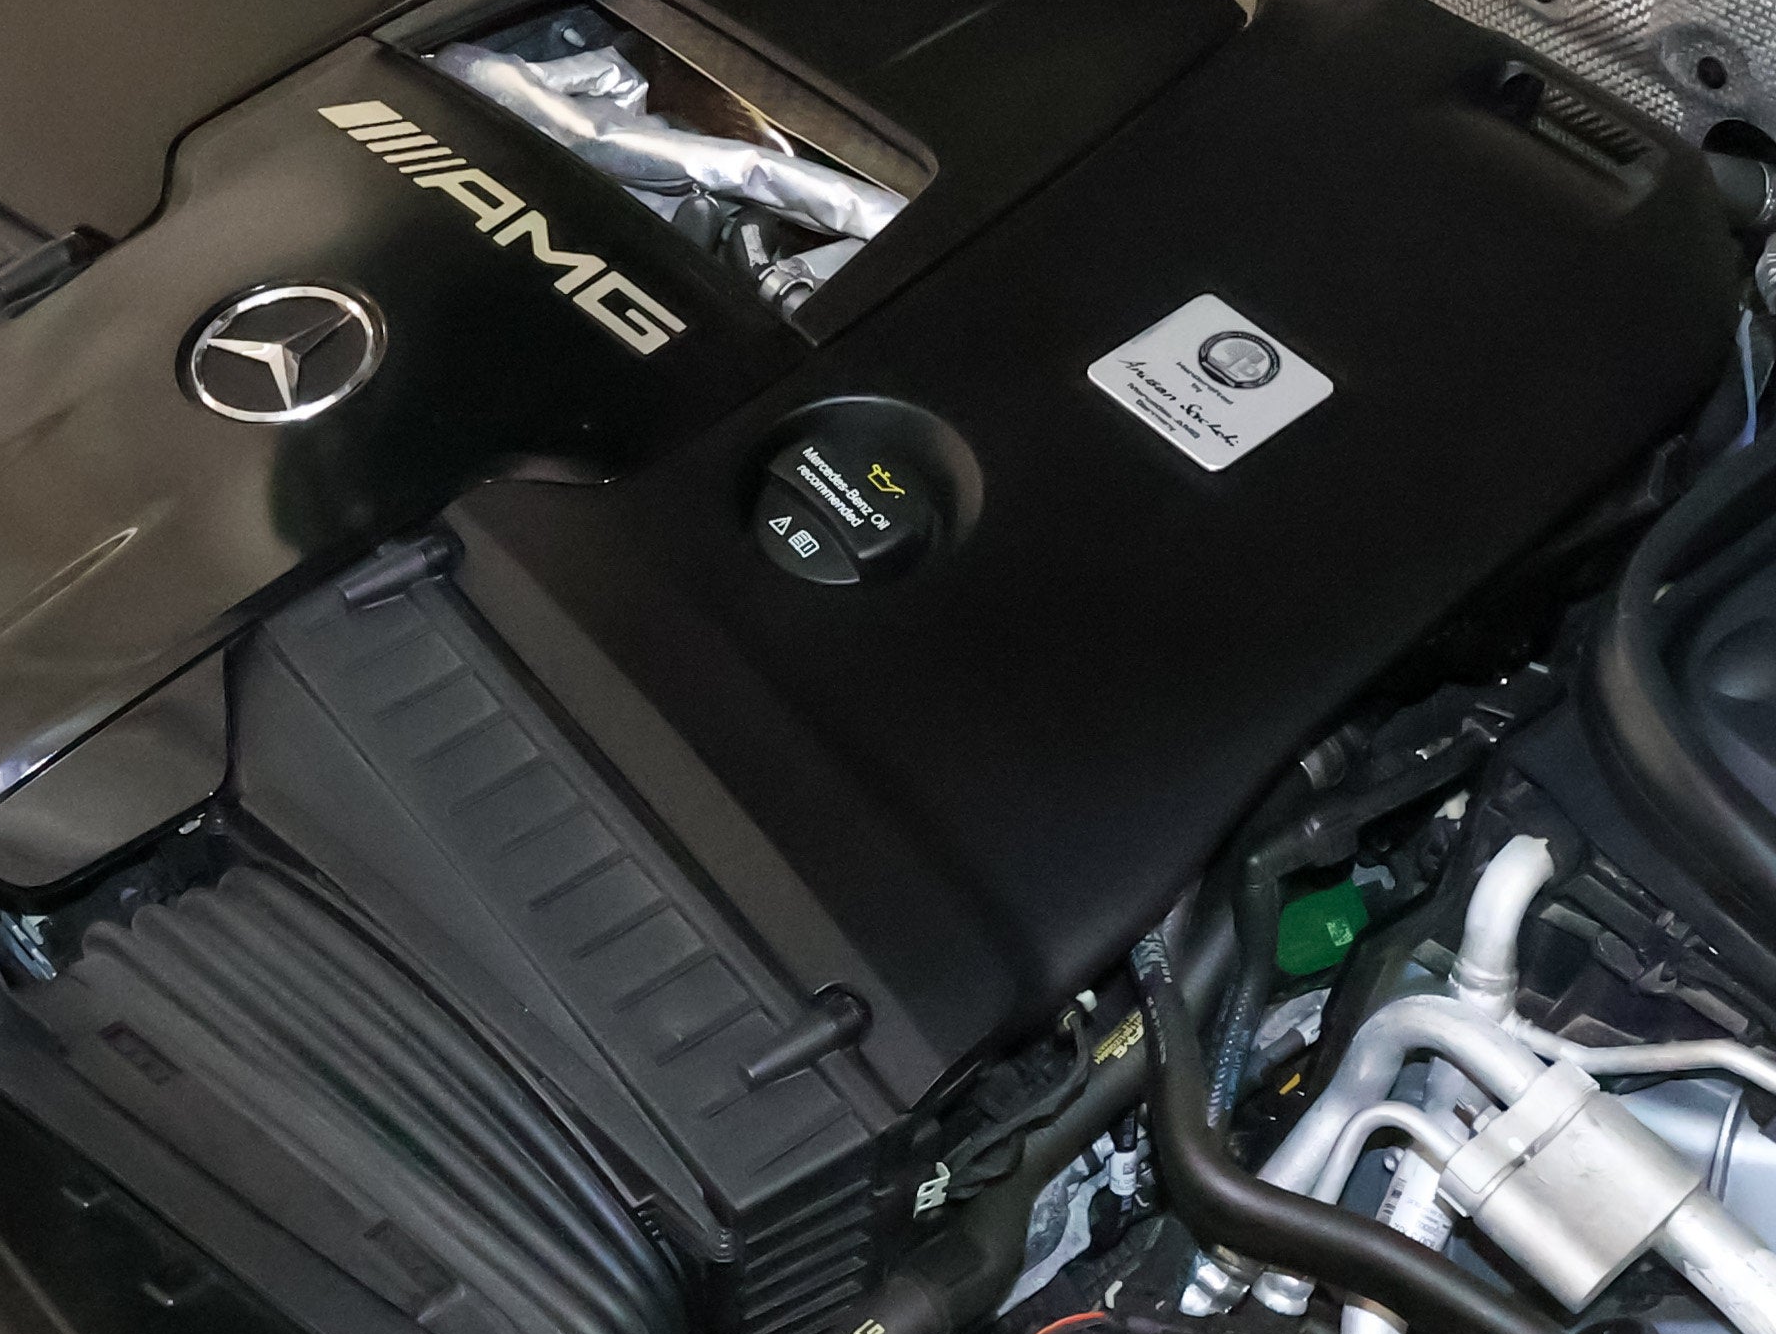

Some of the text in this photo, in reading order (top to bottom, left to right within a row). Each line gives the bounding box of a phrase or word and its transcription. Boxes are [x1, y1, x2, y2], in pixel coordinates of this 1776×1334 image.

[413, 166, 688, 356] AMG
[796, 464, 866, 528] recommended
[801, 445, 892, 531] Mercedes-Benz Oil
